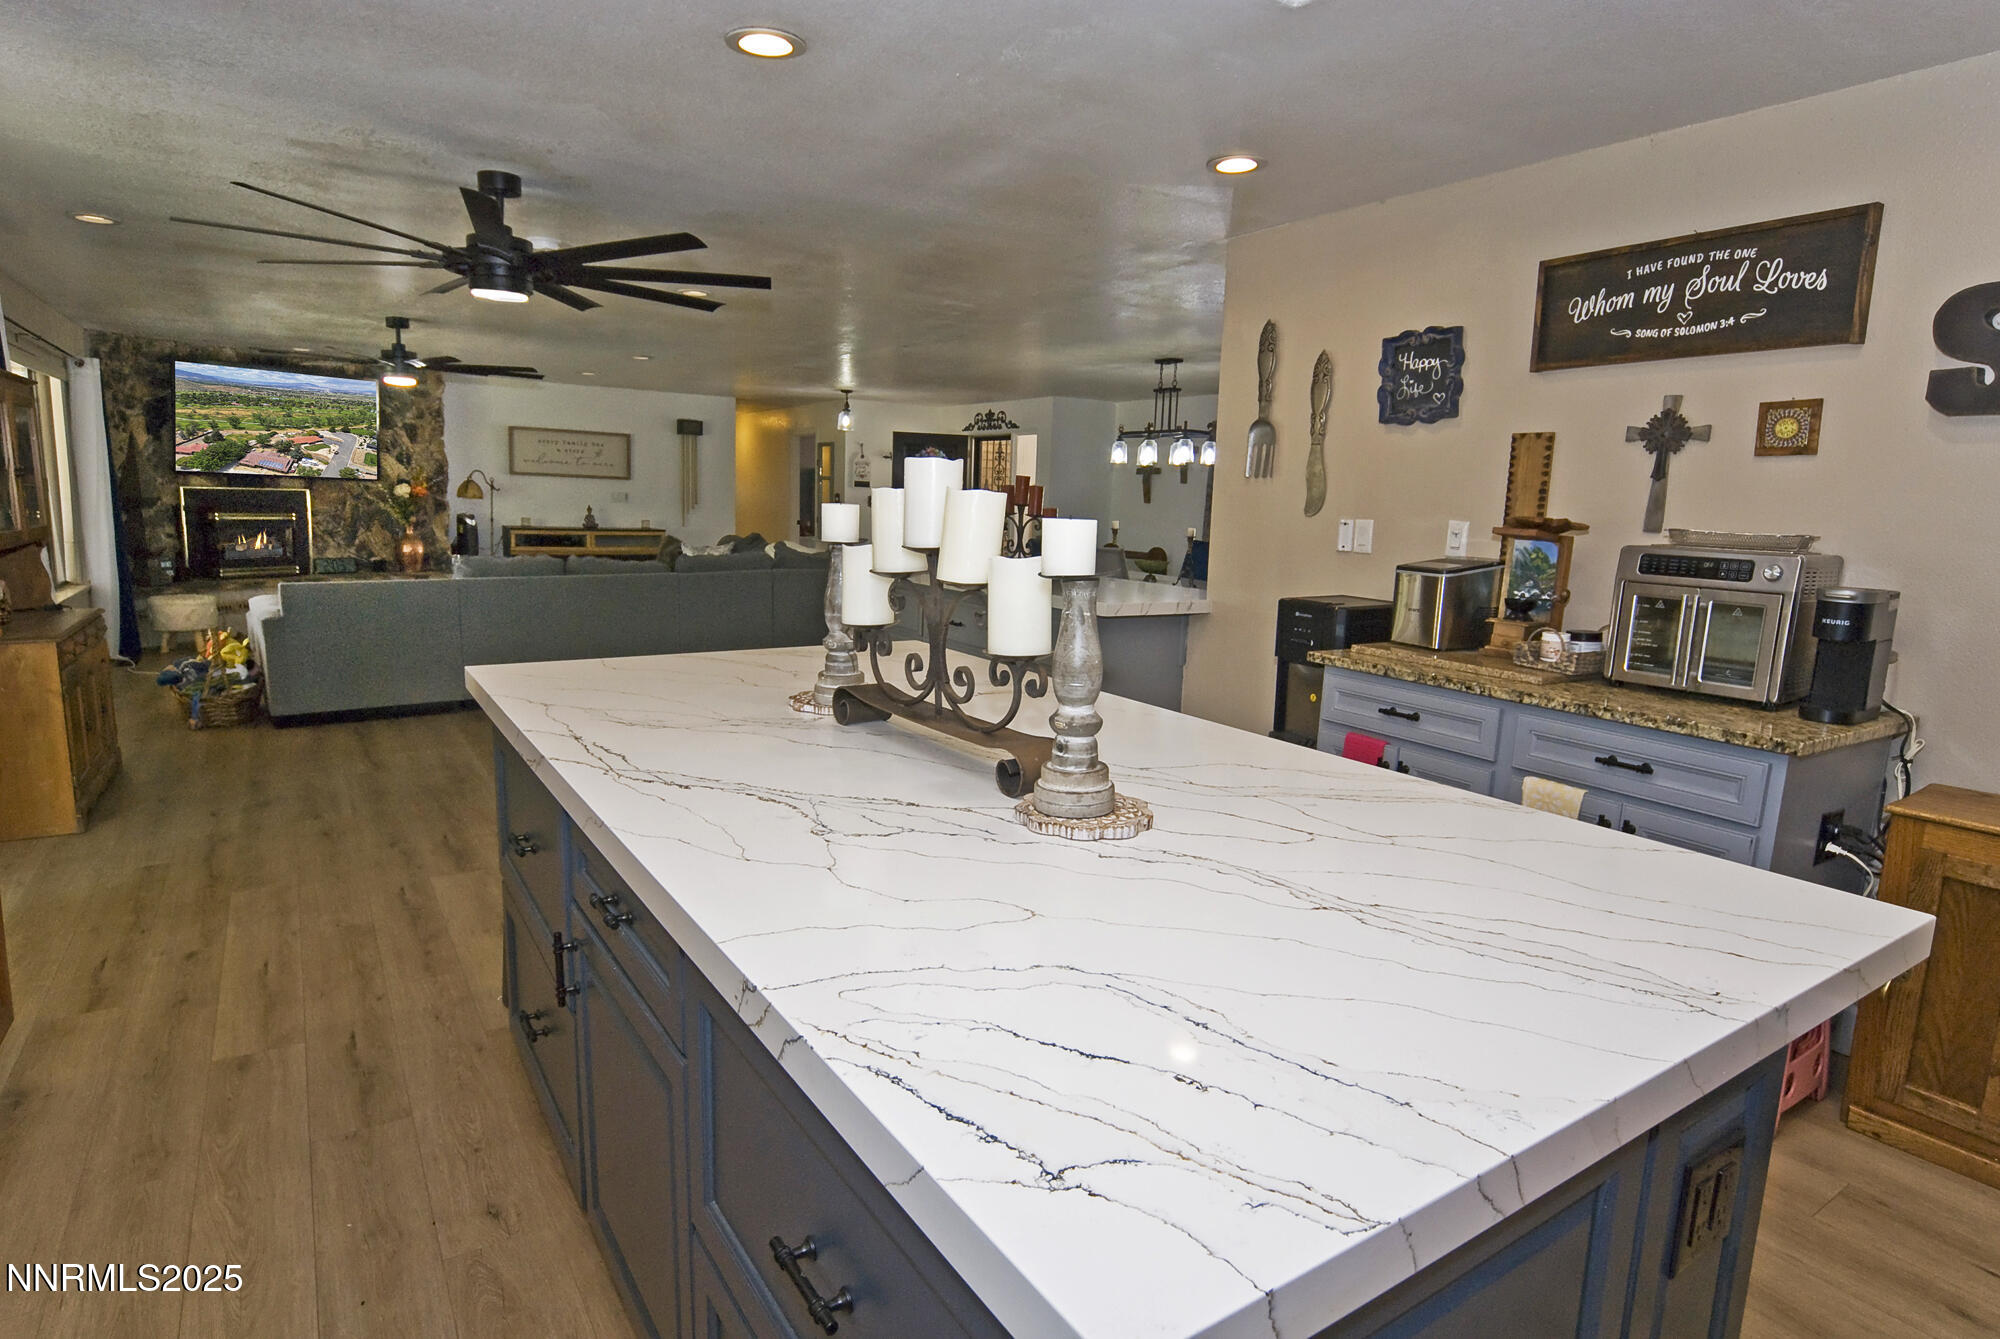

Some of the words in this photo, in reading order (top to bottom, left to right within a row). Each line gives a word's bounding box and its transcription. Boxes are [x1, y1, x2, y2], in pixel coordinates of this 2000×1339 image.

[1626, 269, 1633, 280] I
[1636, 260, 1663, 276] HAVE
[1667, 253, 1704, 269] FOUND
[1708, 249, 1731, 261] THE
[1734, 247, 1758, 260] ONE
[1568, 287, 1635, 324] Whom
[1642, 282, 1675, 313] my
[1684, 259, 1750, 310] Soul
[1753, 257, 1828, 294] Loves
[1635, 328, 1659, 338] SONG
[1660, 327, 1672, 338] OF
[1674, 320, 1718, 337] SOLOMON
[1719, 316, 1735, 329] 3:4
[1398, 351, 1448, 380] Happy
[1396, 374, 1434, 400] Life
[1821, 617, 1851, 626] KEURIG
